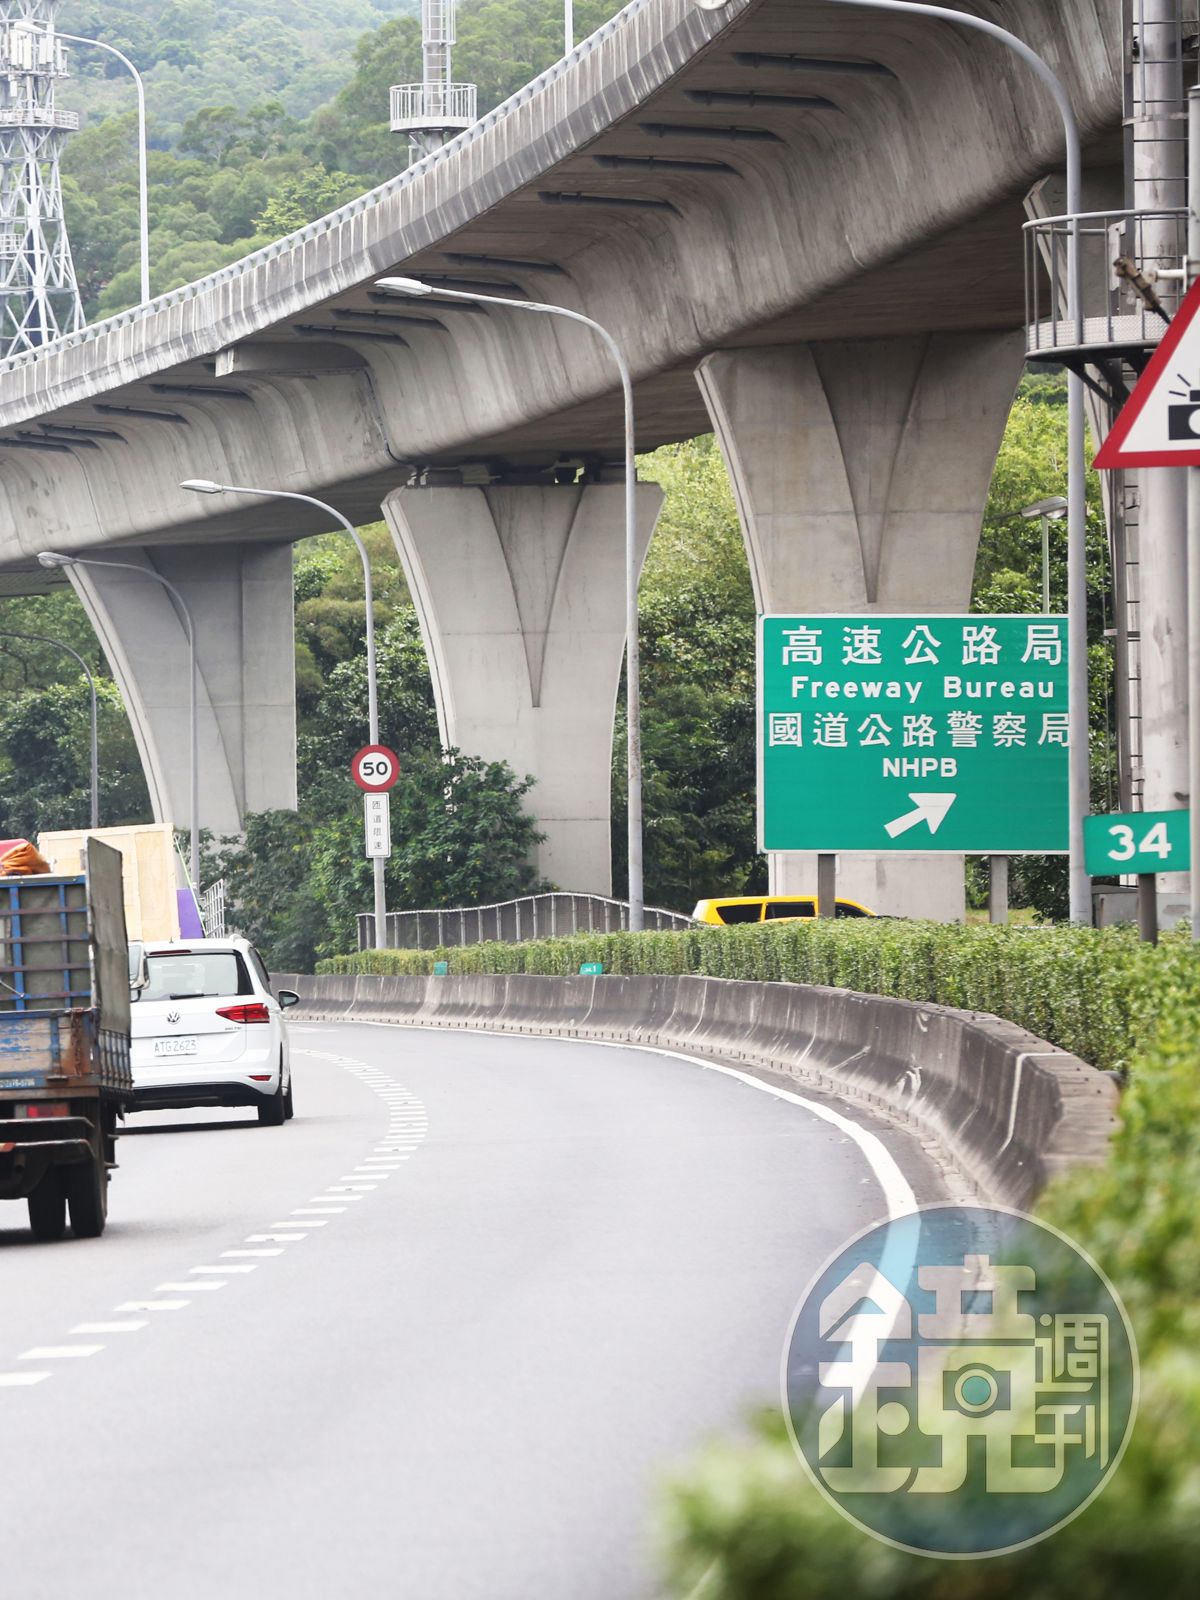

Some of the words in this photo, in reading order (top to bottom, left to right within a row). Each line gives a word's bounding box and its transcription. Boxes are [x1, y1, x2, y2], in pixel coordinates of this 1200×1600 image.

[781, 625, 1063, 665] 高速公路局
[791, 676, 922, 703] Freeway
[943, 676, 1054, 699] Bureau
[768, 711, 1069, 748] 國道公路警察局
[362, 761, 388, 777] 50
[883, 757, 958, 778] NHPB
[1107, 822, 1172, 861] 34
